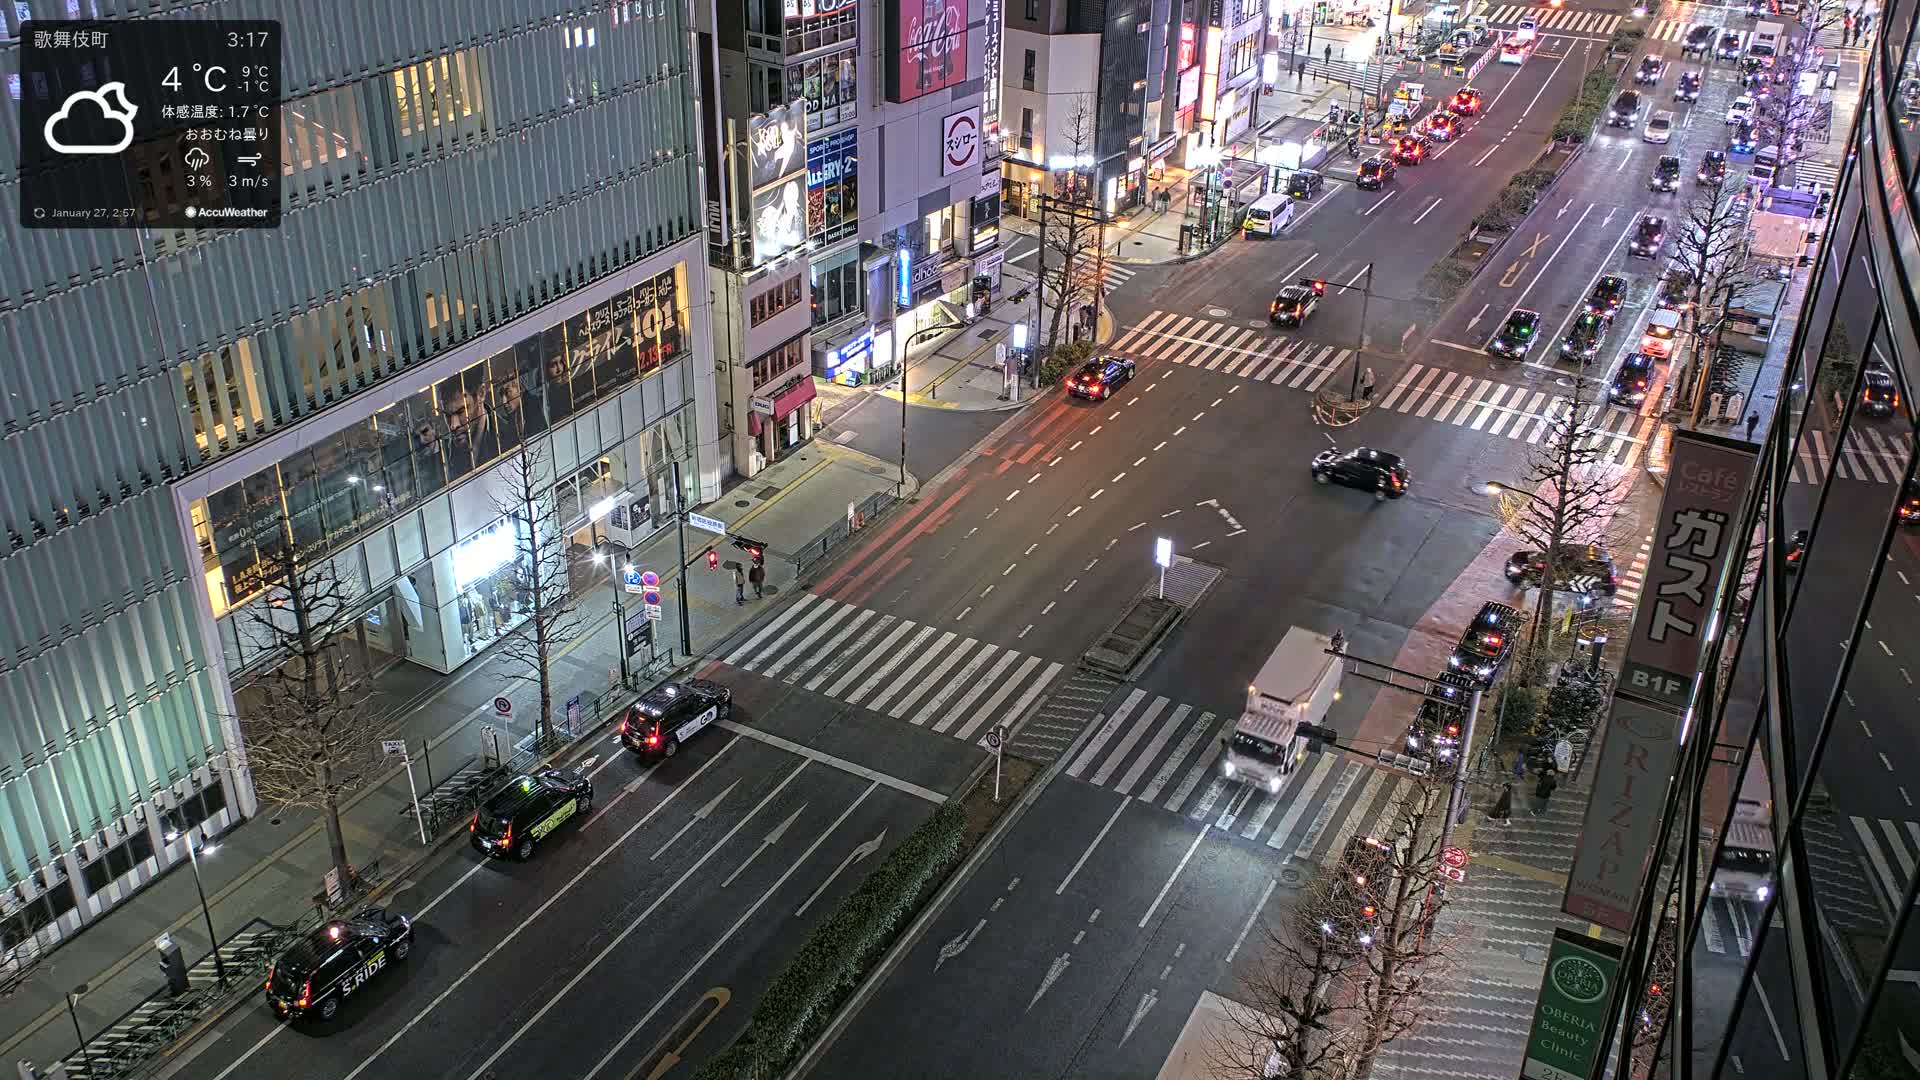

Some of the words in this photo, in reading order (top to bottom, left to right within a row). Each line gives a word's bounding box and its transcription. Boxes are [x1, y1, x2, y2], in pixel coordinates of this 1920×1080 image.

[907, 6, 960, 63] Coca-Cola
[946, 133, 977, 153] スシロー
[708, 200, 721, 233] MUJI
[827, 224, 856, 241] BASKETBALL
[1649, 511, 1726, 642] ガスト
[1631, 670, 1681, 695] B1F
[700, 711, 714, 726] GO
[1596, 743, 1650, 883] RIZAP
[342, 954, 387, 997] S.RIDE
[1541, 1005, 1595, 1032] OBERIA
[1541, 1020, 1589, 1047] Beauty
[1540, 1039, 1583, 1061] Clinic
